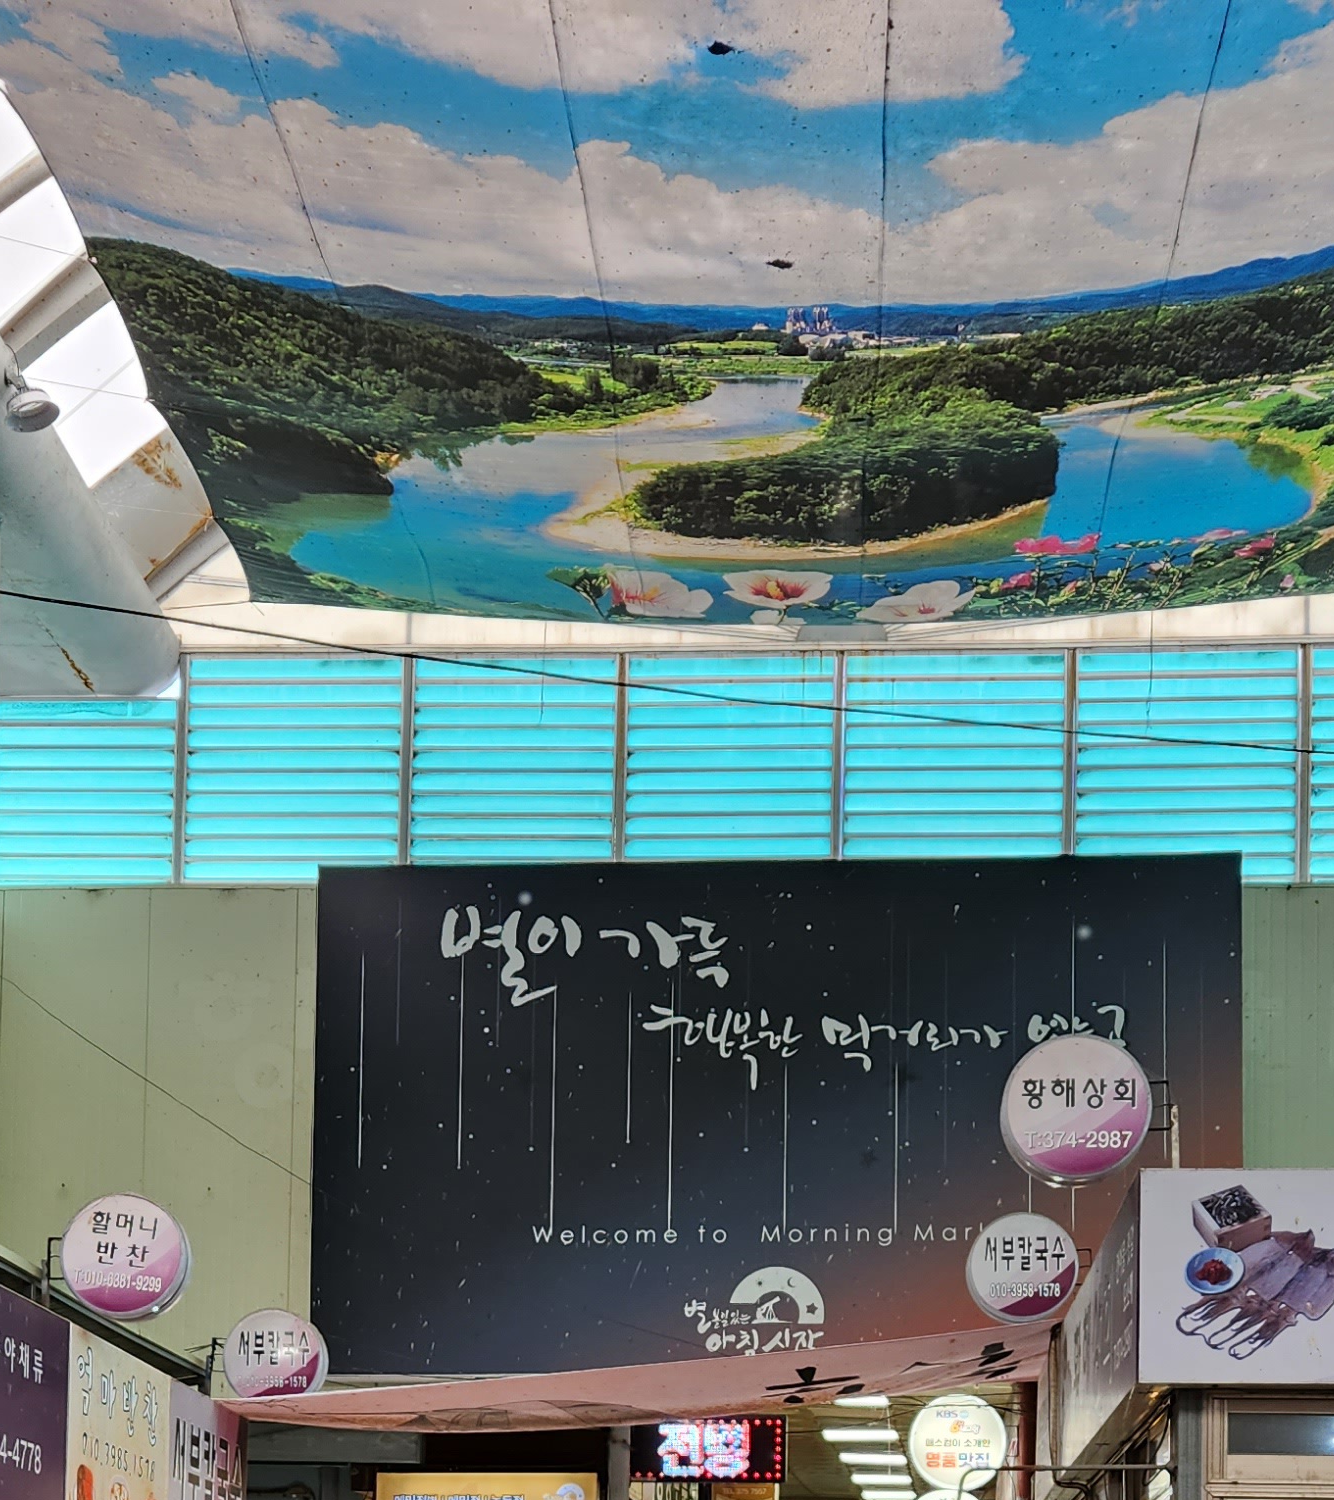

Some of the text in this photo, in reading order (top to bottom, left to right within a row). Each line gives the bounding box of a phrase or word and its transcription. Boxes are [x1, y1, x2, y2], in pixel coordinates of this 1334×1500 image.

[441, 905, 729, 1006] 별이 가득
[642, 1004, 1009, 1091] 행복한 먹거리가
[1021, 1077, 1138, 1109] 황해상회
[1025, 1130, 1134, 1150] T:374-2987
[92, 1210, 159, 1240] 할머니
[533, 1222, 985, 1249] Welcome to Morning Mar
[95, 1241, 150, 1269] 반찬
[984, 1235, 1067, 1273] 서부칼국수
[989, 1282, 1061, 1298] 010-3958-1578
[237, 1330, 312, 1368] 서부칼국수
[77, 1346, 159, 1448] 엄마반찬
[936, 1409, 958, 1418] KBS
